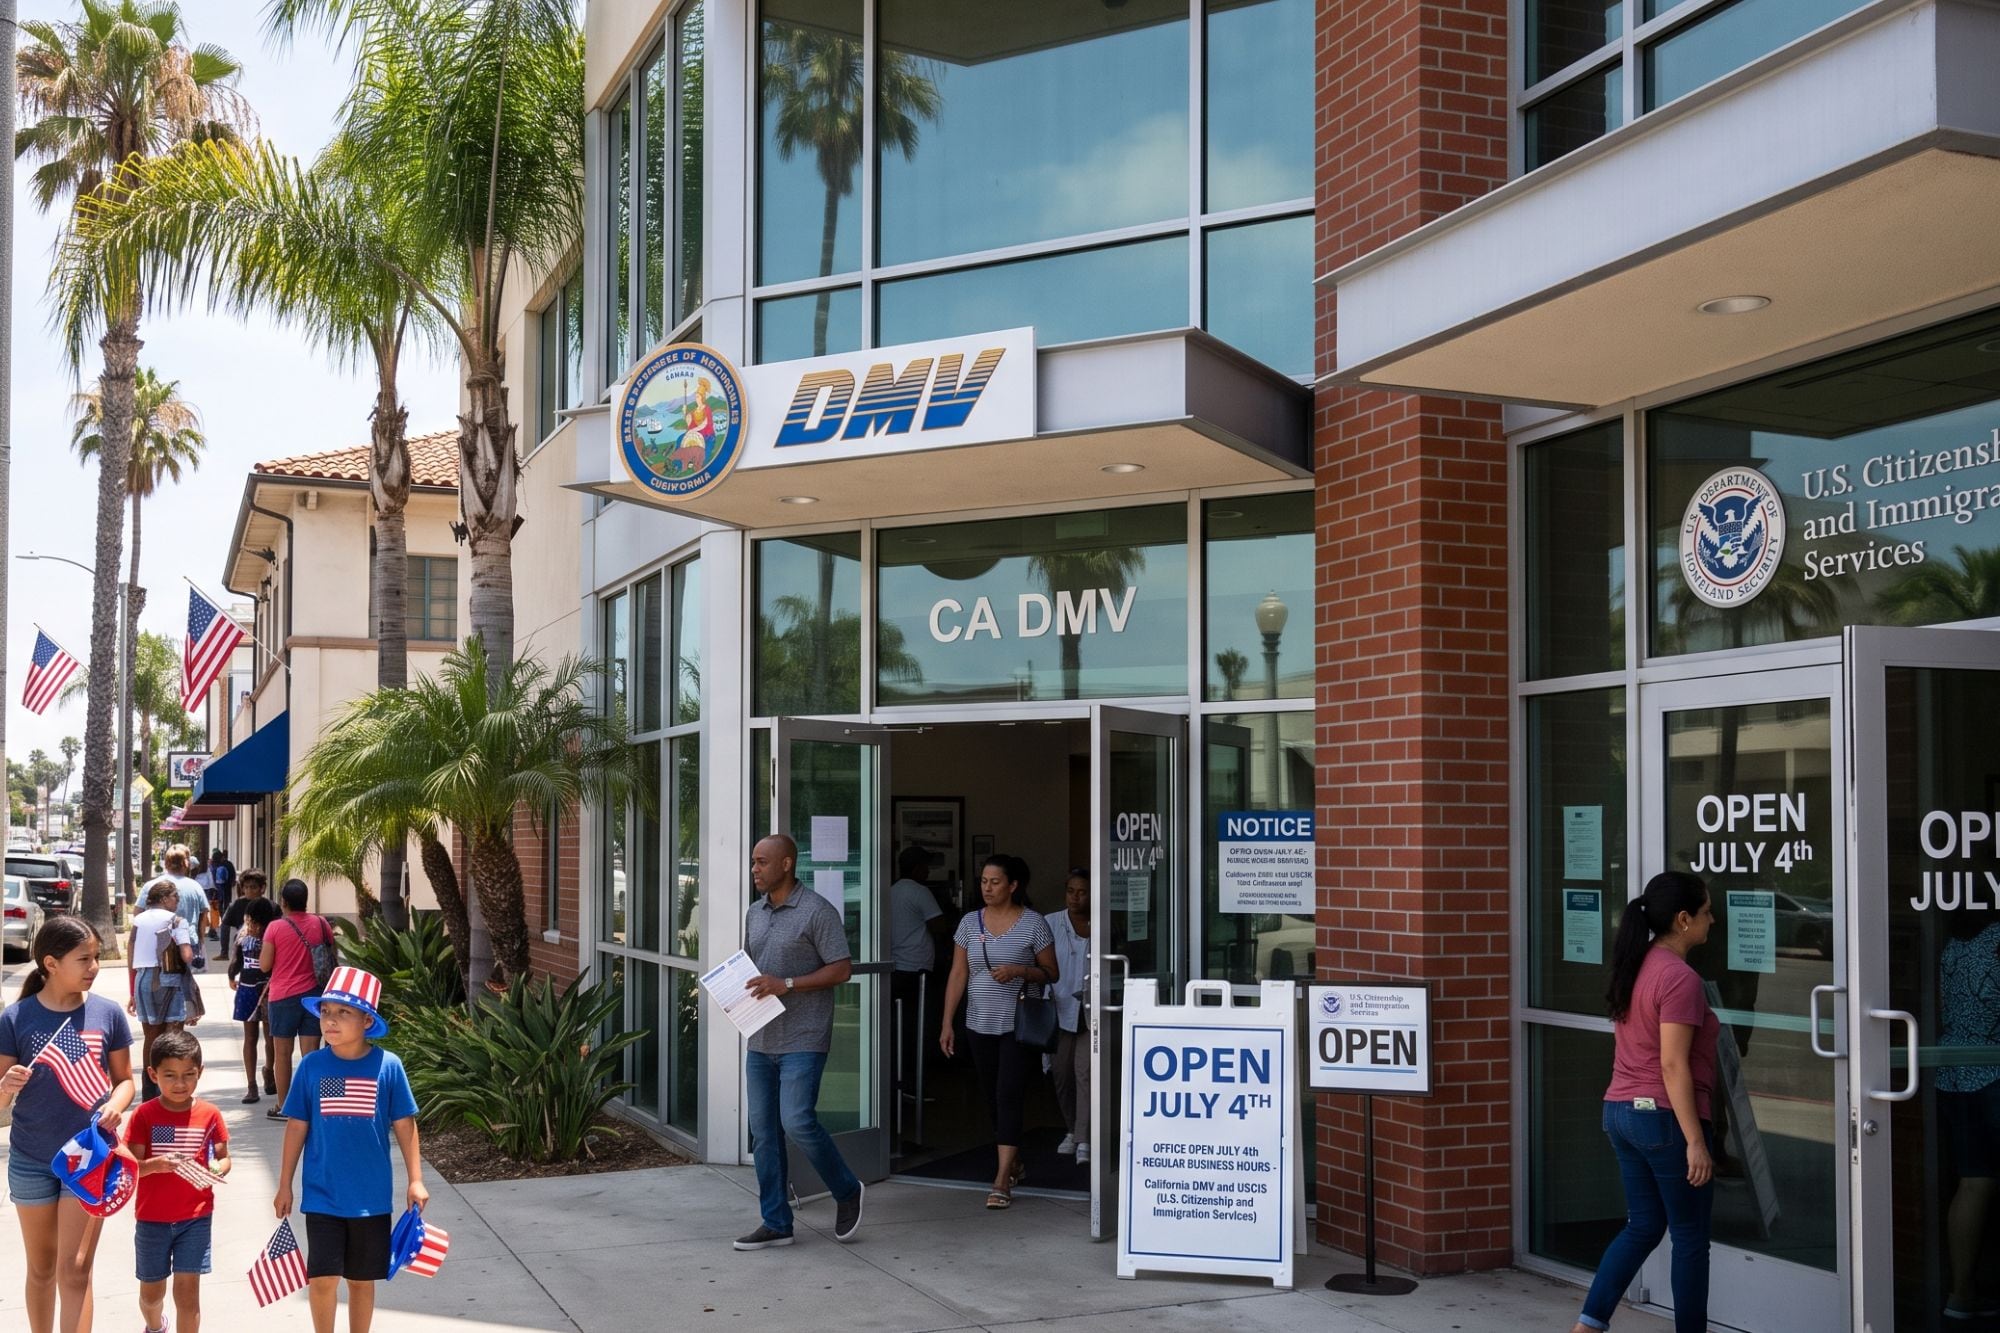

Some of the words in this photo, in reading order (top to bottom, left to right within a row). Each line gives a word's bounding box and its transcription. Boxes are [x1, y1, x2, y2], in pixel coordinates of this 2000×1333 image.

[773, 347, 1007, 448] DMV
[1700, 474, 1770, 503] DEPARTMENT
[1766, 500, 1778, 519] OF
[1802, 464, 1853, 500] U.S.
[1803, 501, 1857, 541] and
[1685, 552, 1734, 600] HOMELAND
[1804, 540, 1925, 581] Services
[929, 596, 1002, 643] CA
[1018, 586, 1137, 638] DMV
[1116, 812, 1161, 842] OPEN
[1227, 818, 1311, 837] NOTICE
[1696, 792, 1806, 833] OPEN
[1920, 810, 2000, 859] OP
[1113, 847, 1146, 871] JULY
[1148, 845, 1164, 871] 4th
[1690, 842, 1767, 874] JULY
[1774, 840, 1813, 874] 4th
[1143, 1045, 1270, 1084] OPEN
[1318, 1027, 1417, 1066] OPEN
[1143, 1091, 1220, 1119] JULY
[1228, 1094, 1271, 1120] 4TH
[1142, 1157, 1185, 1169] REGULAR
[1187, 1159, 1234, 1171] BUSINESS
[1236, 1161, 1270, 1172] HOURS
[1153, 1143, 1187, 1154] OFFICE
[1188, 1144, 1214, 1155] OPEN
[1216, 1146, 1240, 1156] JULY
[1242, 1147, 1259, 1157] 4th
[1144, 1178, 1190, 1190] California
[1192, 1181, 1215, 1191] DMV
[1217, 1182, 1235, 1192] and
[1237, 1182, 1268, 1193] USCIS
[1156, 1192, 1179, 1205] (U.S.
[1181, 1194, 1234, 1208] Citizenship
[1236, 1197, 1254, 1207] and
[1153, 1207, 1210, 1220] Immigration
